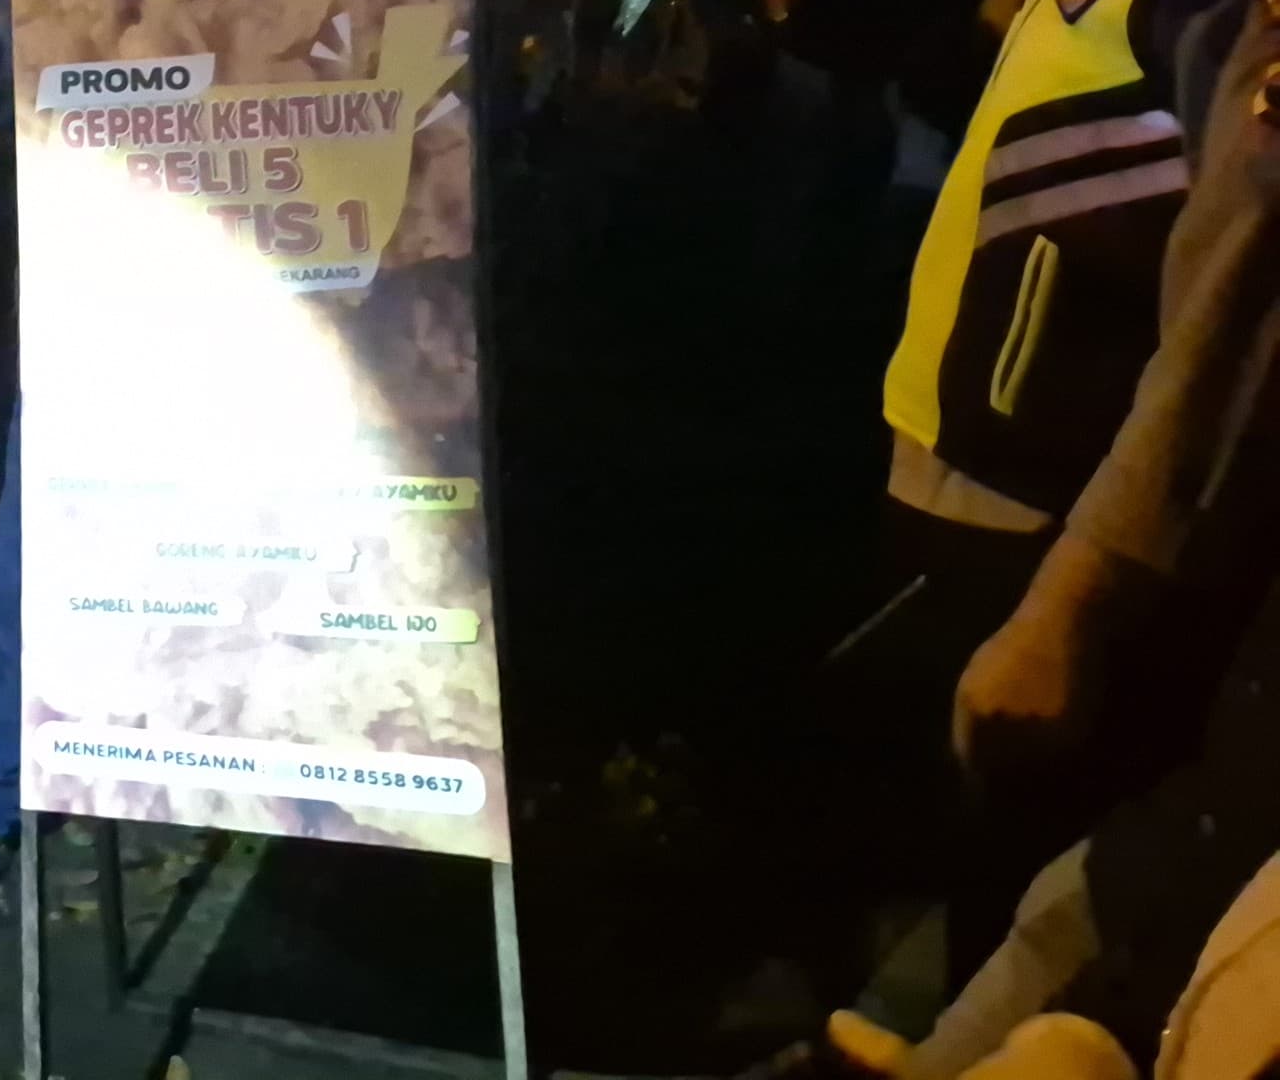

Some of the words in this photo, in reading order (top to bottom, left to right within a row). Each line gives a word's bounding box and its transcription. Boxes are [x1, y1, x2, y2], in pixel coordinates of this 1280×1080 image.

[60, 65, 191, 95] PROMO
[61, 102, 206, 150] GEPREK
[211, 89, 402, 140] KENTUKY
[126, 149, 247, 195] BELI
[263, 146, 303, 193] 5
[336, 199, 369, 251] 1
[274, 266, 361, 282] EKARANG
[69, 597, 135, 613] SAMBEL
[142, 599, 219, 616] BAWANG
[319, 611, 398, 632] SAMBEL
[54, 740, 157, 762] MENERIMA
[162, 750, 256, 773] PESANAN
[299, 763, 348, 783] 0812
[354, 768, 407, 788] 8558
[411, 774, 463, 794] 9637
